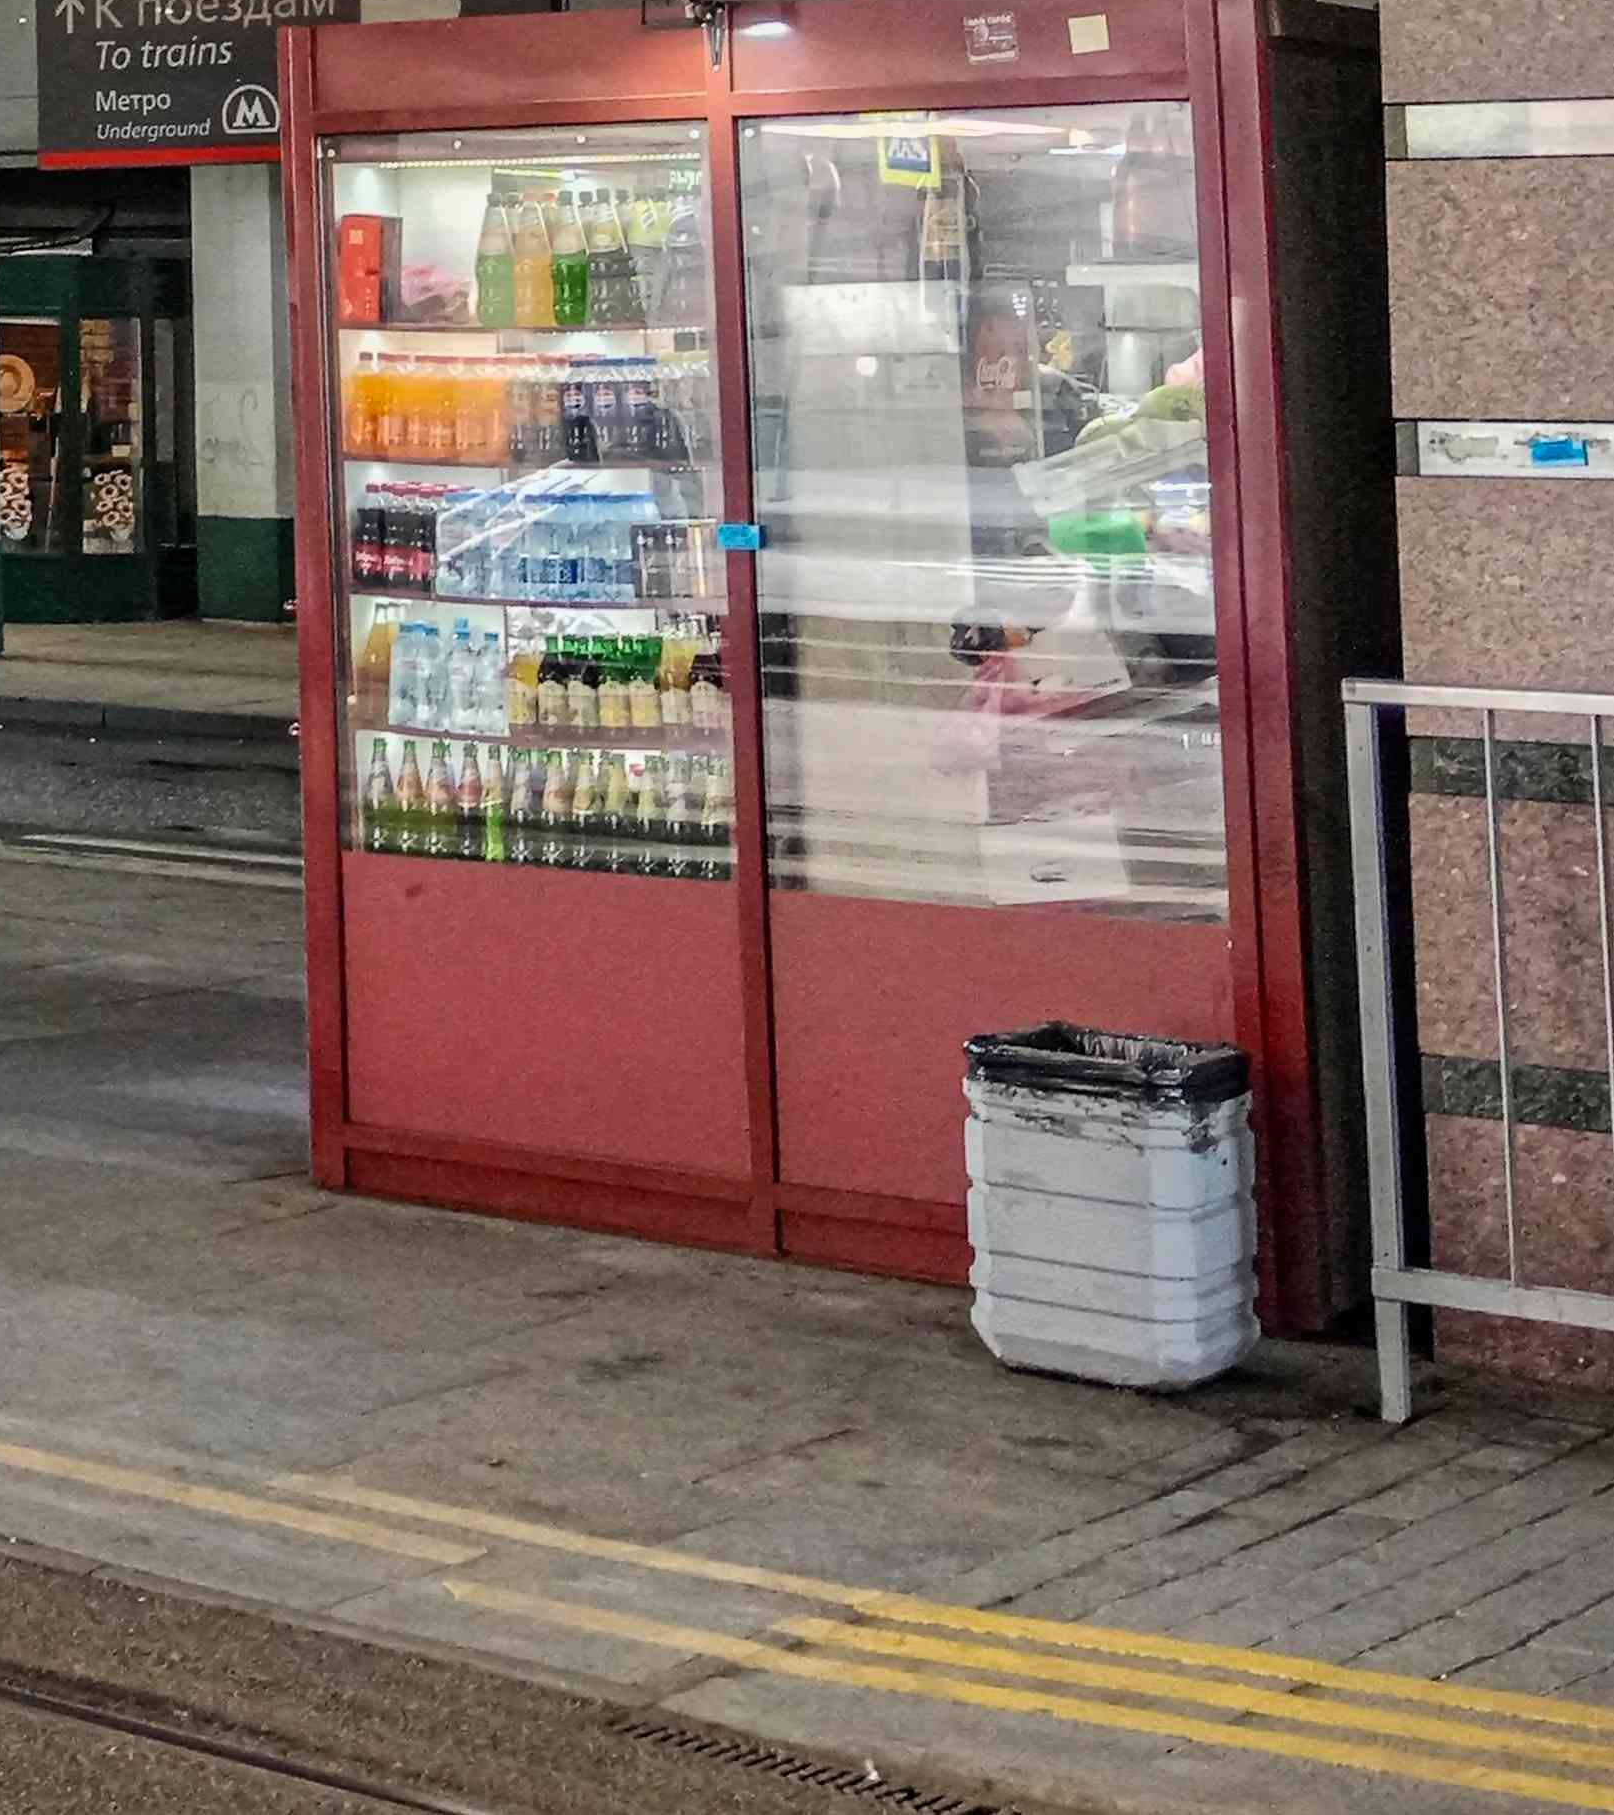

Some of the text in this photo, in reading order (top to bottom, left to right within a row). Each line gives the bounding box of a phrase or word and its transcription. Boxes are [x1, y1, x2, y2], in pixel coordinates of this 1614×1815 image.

[96, 35, 233, 71] To trains
[95, 89, 171, 116] Метро
[97, 118, 211, 142] Underground
